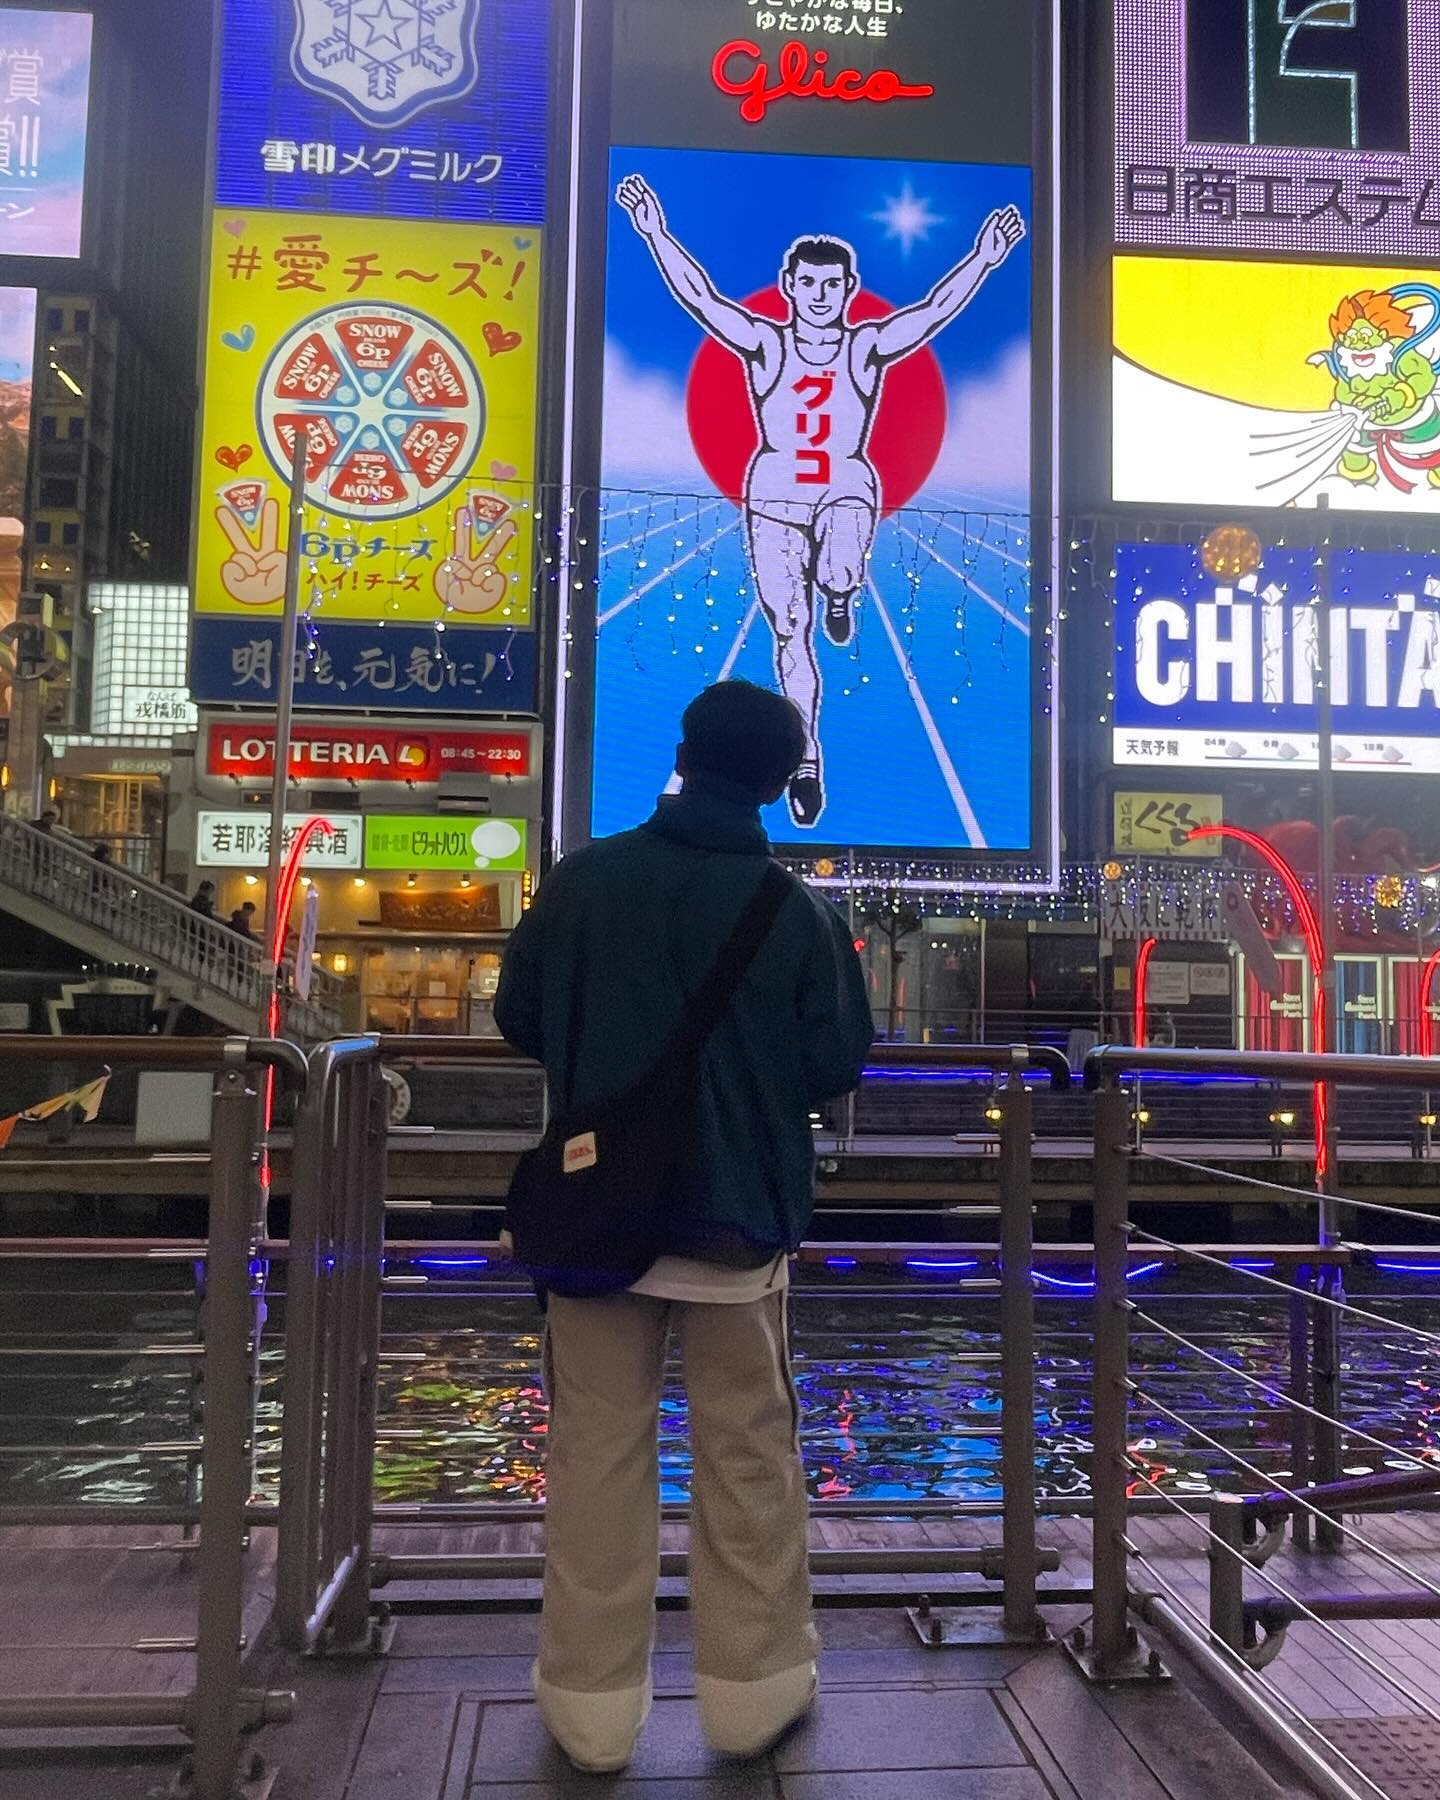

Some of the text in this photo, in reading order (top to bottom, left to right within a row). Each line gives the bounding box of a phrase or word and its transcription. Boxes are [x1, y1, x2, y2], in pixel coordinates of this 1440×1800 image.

[756, 11, 889, 37] ゆたかな人生
[712, 40, 933, 122] Glico
[261, 139, 502, 184] 雪印メグミルク
[349, 323, 402, 339] SNOW
[283, 343, 319, 390] SNOW
[428, 352, 464, 397] SNOW
[792, 371, 837, 484] グリコ
[424, 432, 460, 480] SNOW
[341, 484, 395, 500] SNOW
[223, 739, 390, 765] LOTTERIA
[1126, 739, 1180, 757] 天気予報
